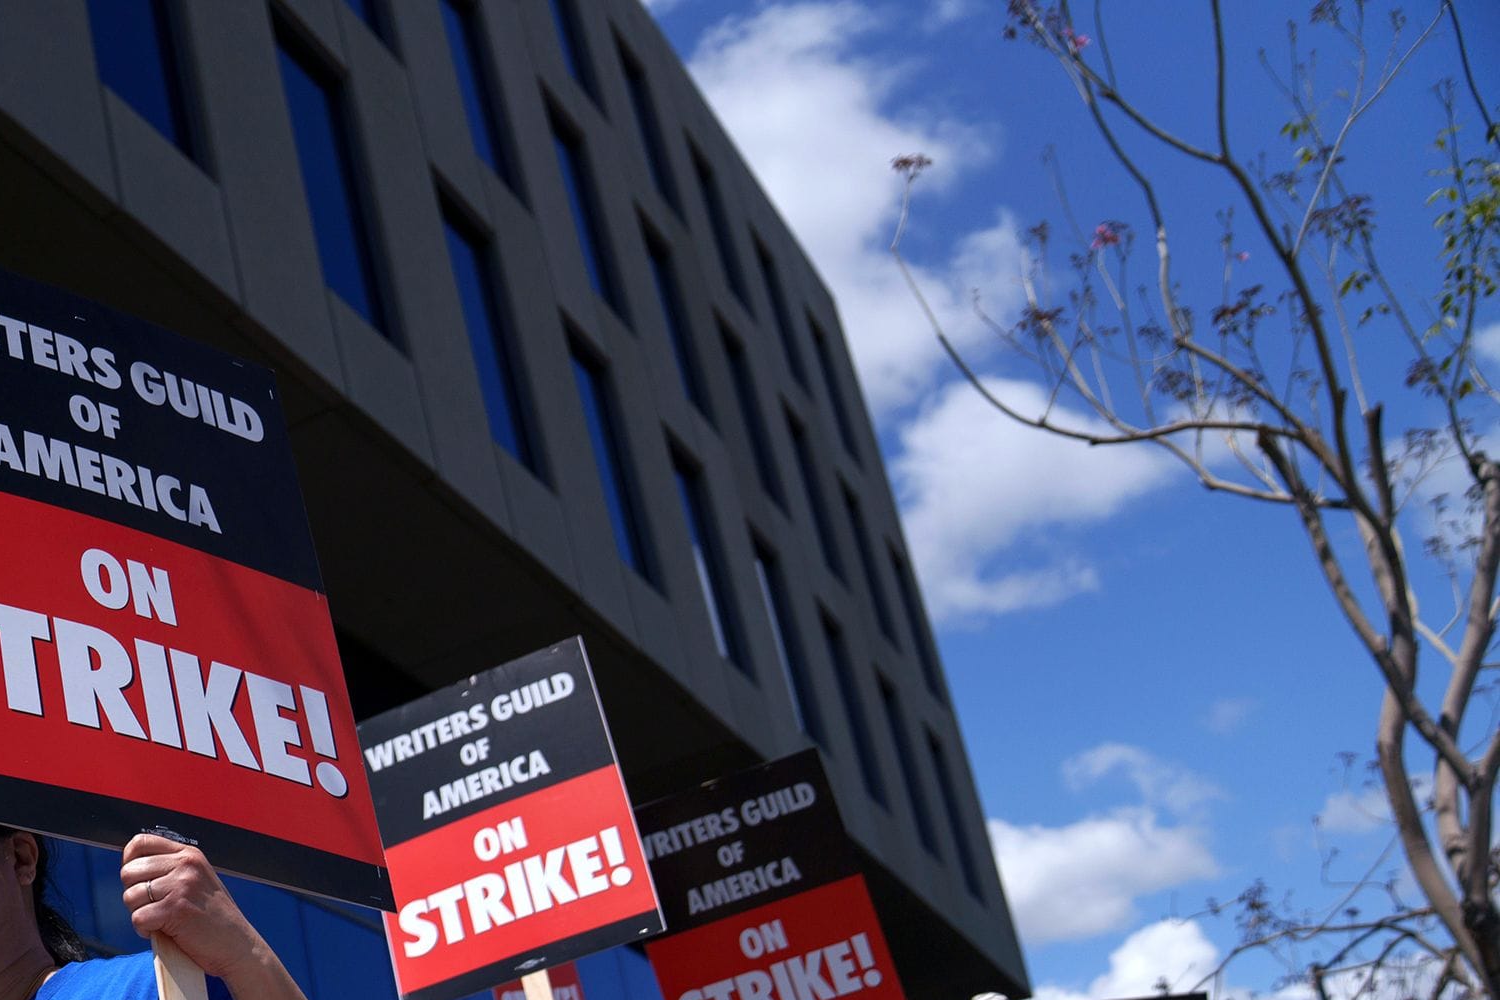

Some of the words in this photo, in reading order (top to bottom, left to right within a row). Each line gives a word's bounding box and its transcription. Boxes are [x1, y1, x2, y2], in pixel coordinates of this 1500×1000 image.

[69, 395, 121, 439] OF
[131, 361, 264, 442] GUILD
[80, 547, 178, 627] ON
[364, 704, 489, 773] WRITERS
[490, 672, 575, 722] GUILD
[460, 737, 491, 766] OF
[423, 750, 551, 820] AMERICA
[740, 782, 817, 827] GUILD
[473, 816, 529, 861] ON
[717, 841, 745, 868] OF
[399, 826, 633, 958] STRIKE!
[687, 856, 802, 915] AMERICA
[739, 919, 789, 959] ON
